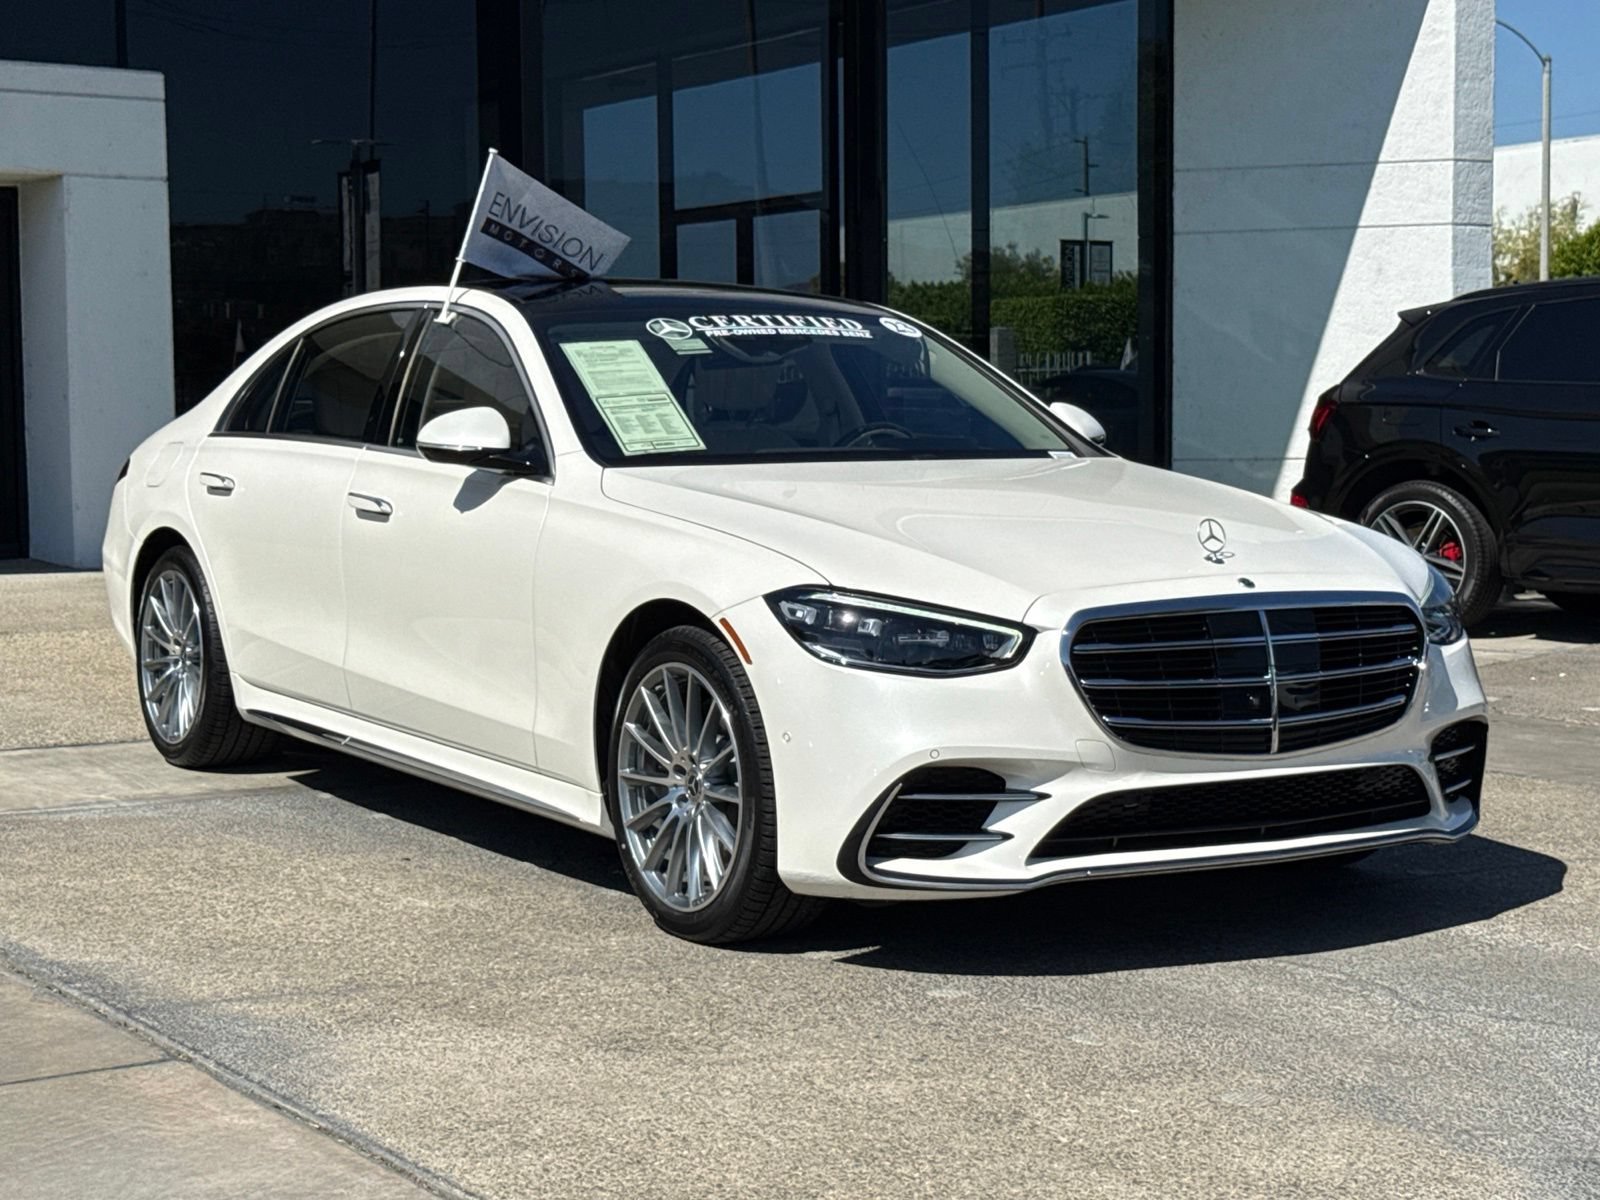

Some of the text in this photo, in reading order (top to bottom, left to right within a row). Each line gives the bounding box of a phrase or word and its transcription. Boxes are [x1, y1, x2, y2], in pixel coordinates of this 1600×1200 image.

[488, 191, 606, 271] ENVISION
[488, 223, 579, 278] MOTORS
[688, 315, 863, 330] CERTIFIED
[705, 328, 873, 339] PRE-OWNED MERCEDES BENZ
